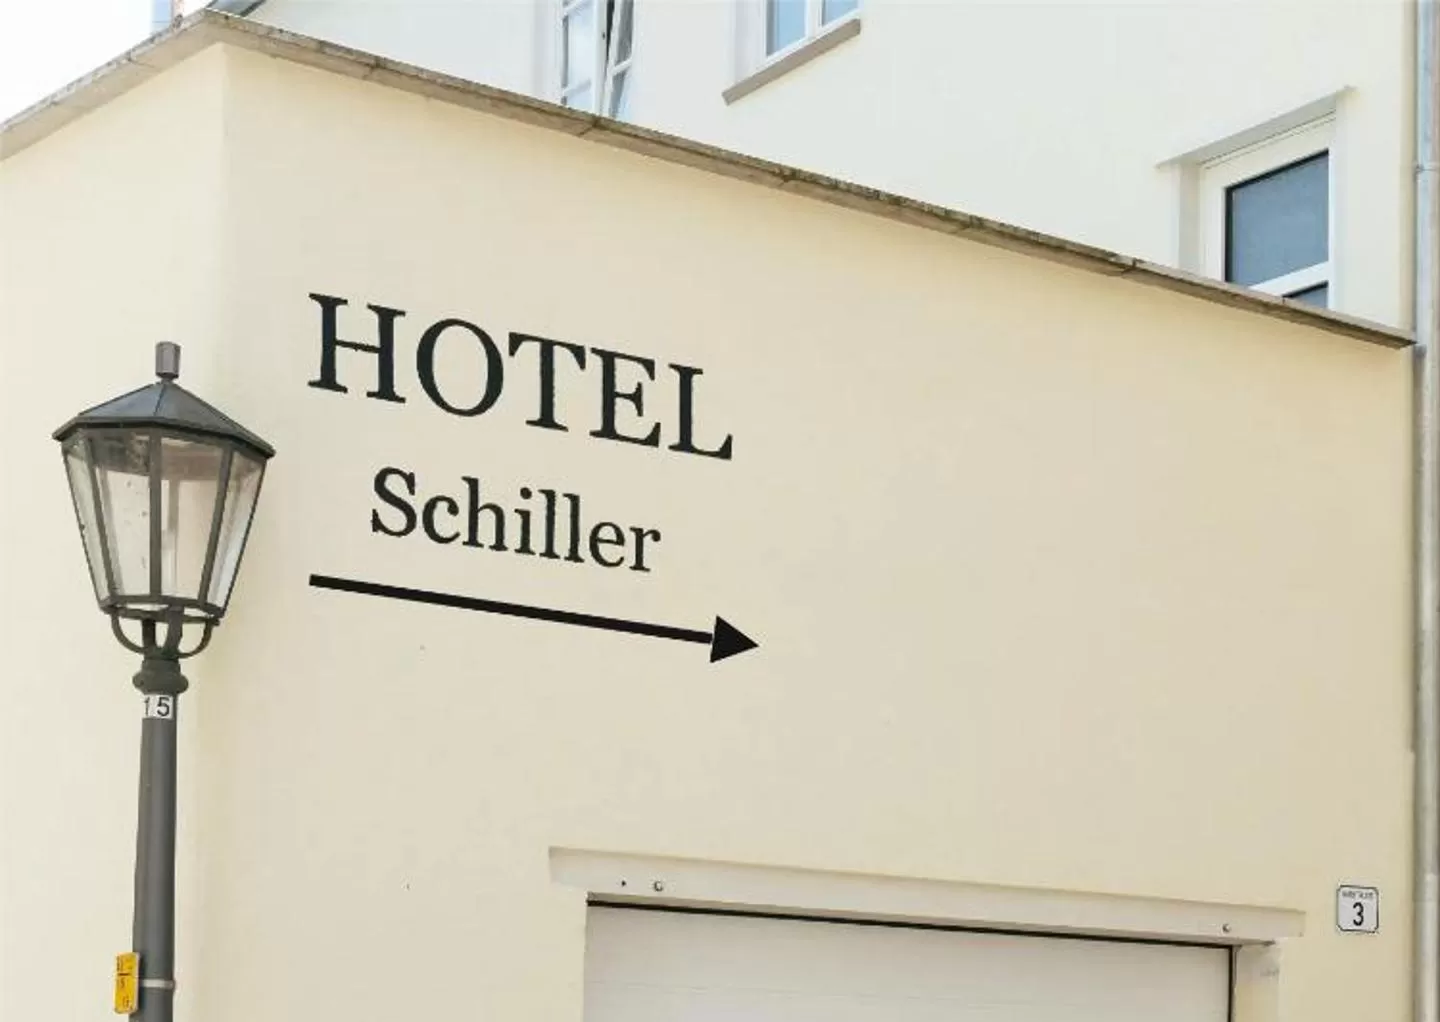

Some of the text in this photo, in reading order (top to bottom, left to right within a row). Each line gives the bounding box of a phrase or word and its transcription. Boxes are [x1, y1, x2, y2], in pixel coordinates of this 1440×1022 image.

[307, 292, 733, 461] HOTEL
[370, 466, 662, 573] Schiller
[1352, 901, 1365, 927] 3
